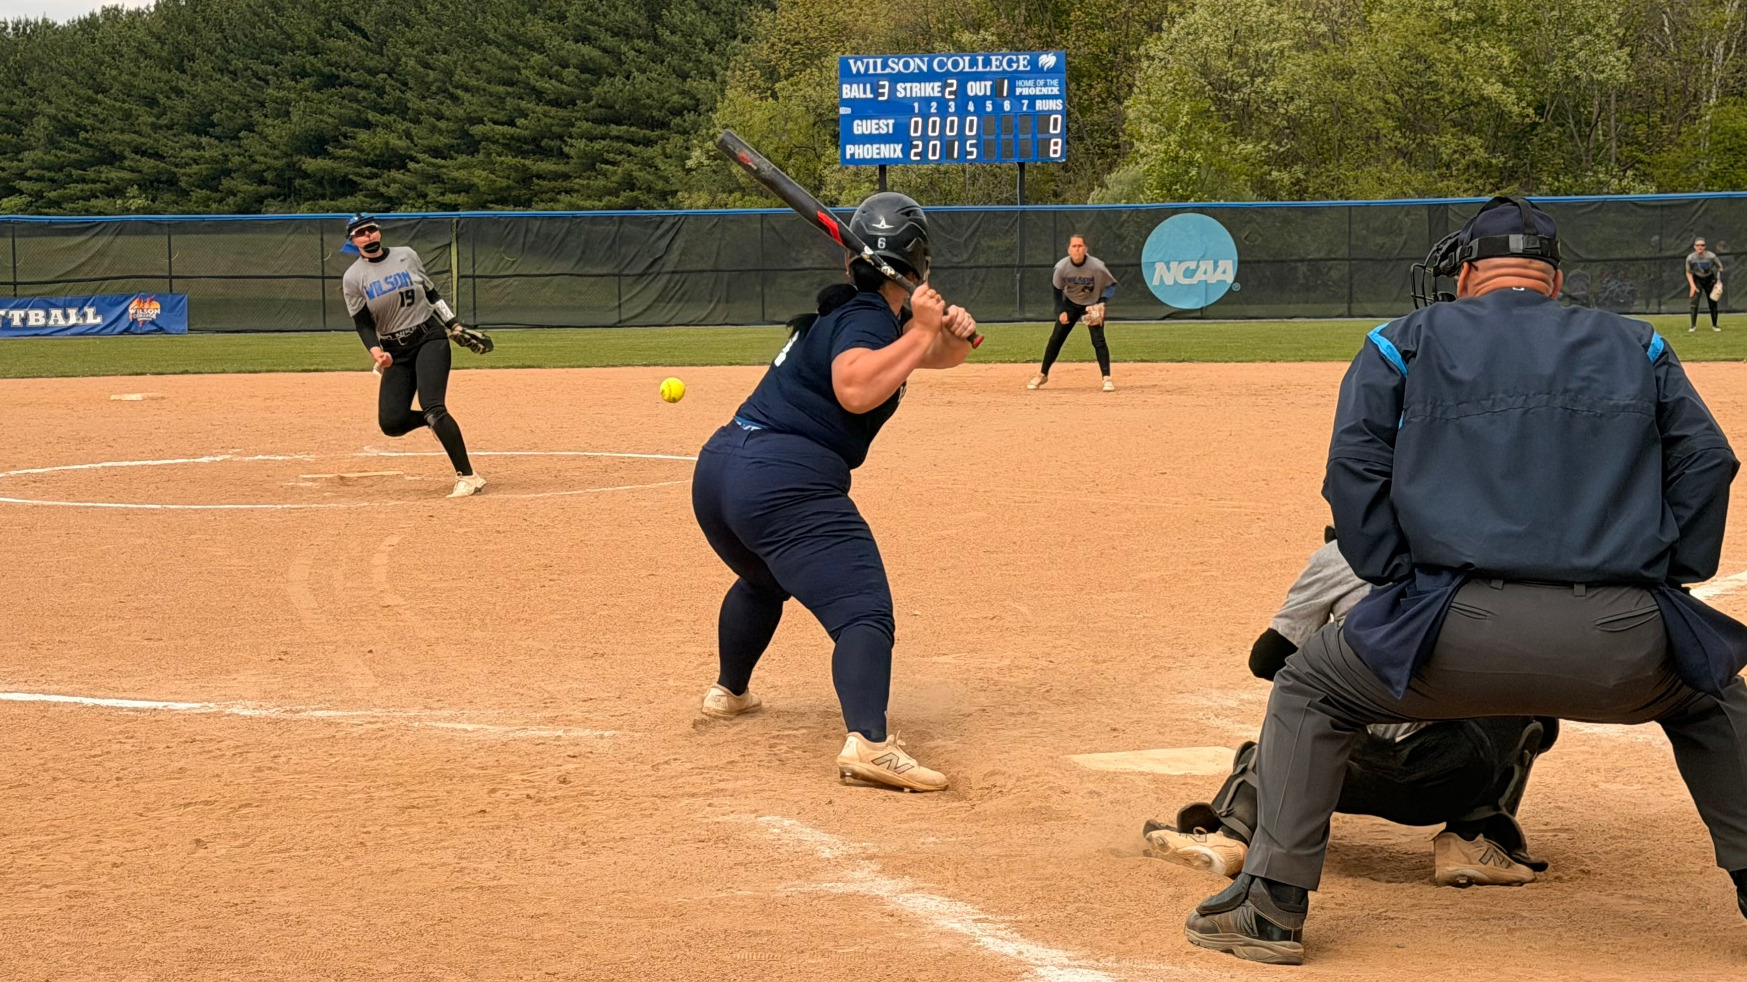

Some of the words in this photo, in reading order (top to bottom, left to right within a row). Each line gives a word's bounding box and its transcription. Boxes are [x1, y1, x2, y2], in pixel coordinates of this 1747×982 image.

[849, 58, 928, 74] WILSON
[933, 55, 1031, 72] COLLEGE
[842, 83, 874, 98] BALL
[878, 81, 889, 100] 3
[896, 82, 942, 98] STRIKE
[945, 79, 957, 99] 2
[967, 81, 993, 96] OUT
[1002, 79, 1009, 97] 1
[1015, 87, 1060, 95] PHOENIX
[1047, 79, 1060, 87] THE
[913, 102, 919, 113] 1
[930, 102, 938, 113] 2
[948, 101, 956, 112] 3
[967, 101, 975, 112] 4
[985, 100, 993, 111] 5
[1003, 100, 1011, 111] 6
[1022, 99, 1029, 110] 7
[1035, 99, 1064, 111] RUNS
[853, 119, 895, 134] GUEST
[910, 117, 922, 136] 0
[928, 117, 940, 136] 0
[946, 116, 958, 136] 0
[965, 116, 978, 135] 0
[1049, 114, 1062, 134] 0
[845, 143, 903, 159] PHOENIX
[910, 140, 923, 160] 2
[928, 140, 941, 160] 0
[965, 140, 977, 159] 5
[1049, 138, 1062, 157] 8
[877, 237, 886, 249] 6
[1152, 259, 1234, 286] NCAA
[364, 270, 414, 300] WILSON
[400, 289, 416, 308] 19
